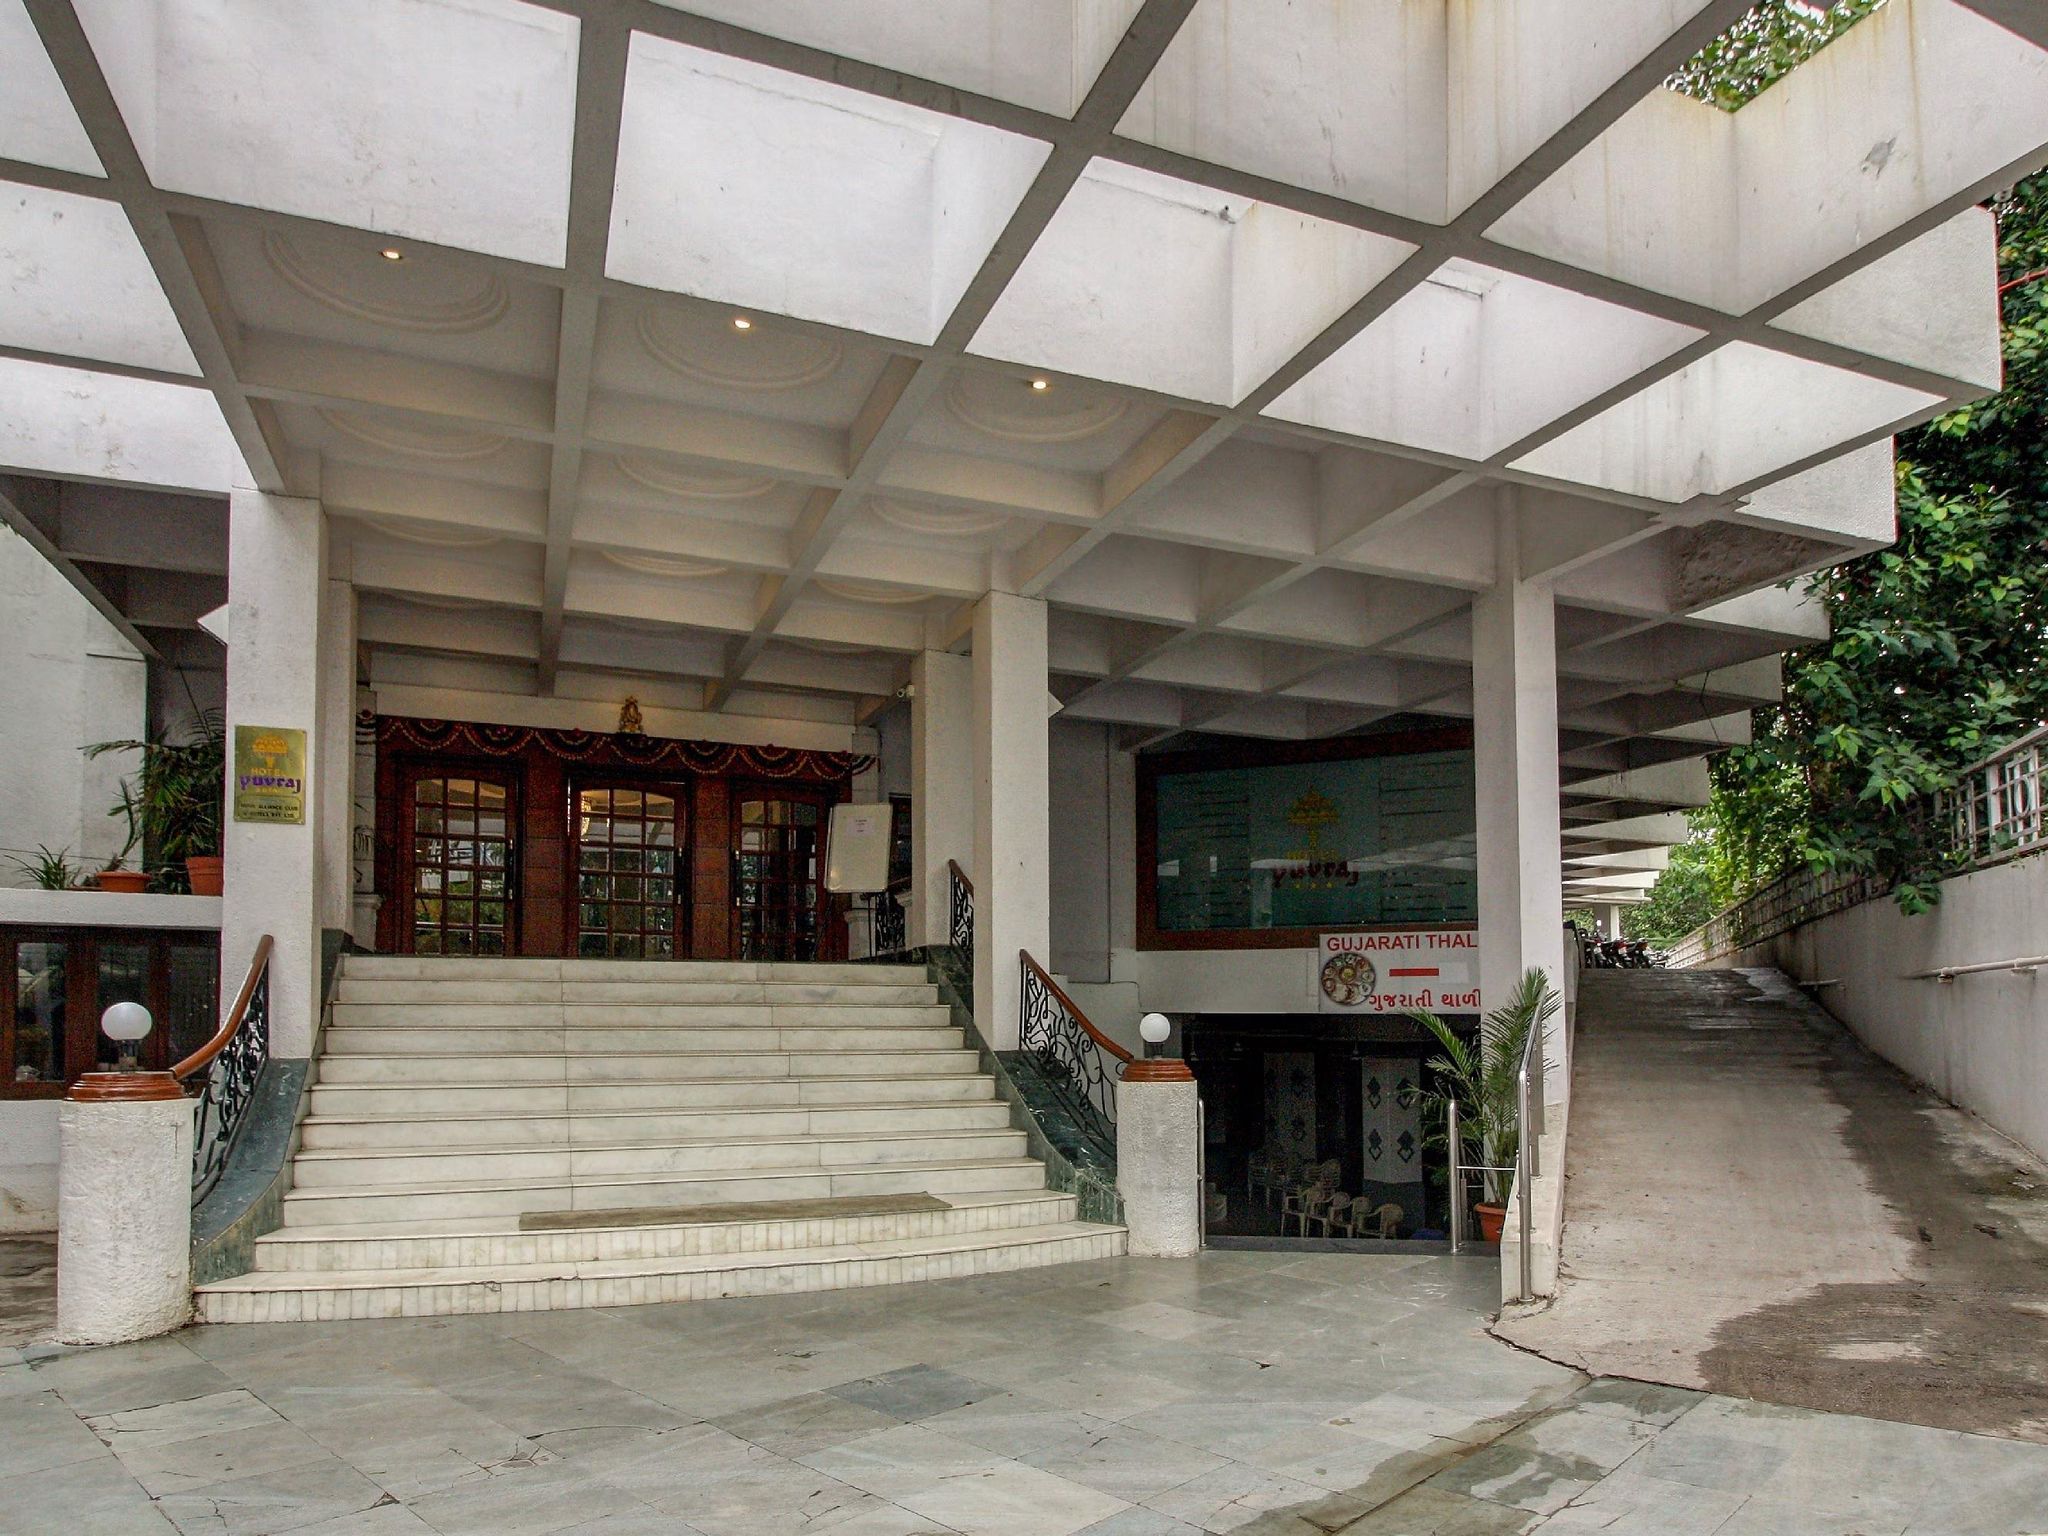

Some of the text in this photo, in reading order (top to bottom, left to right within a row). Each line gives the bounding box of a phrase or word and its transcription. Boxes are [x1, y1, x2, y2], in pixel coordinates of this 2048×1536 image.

[1327, 934, 1478, 950] GUJARATI THAL
[1369, 989, 1433, 1011] ગુજરાતી
